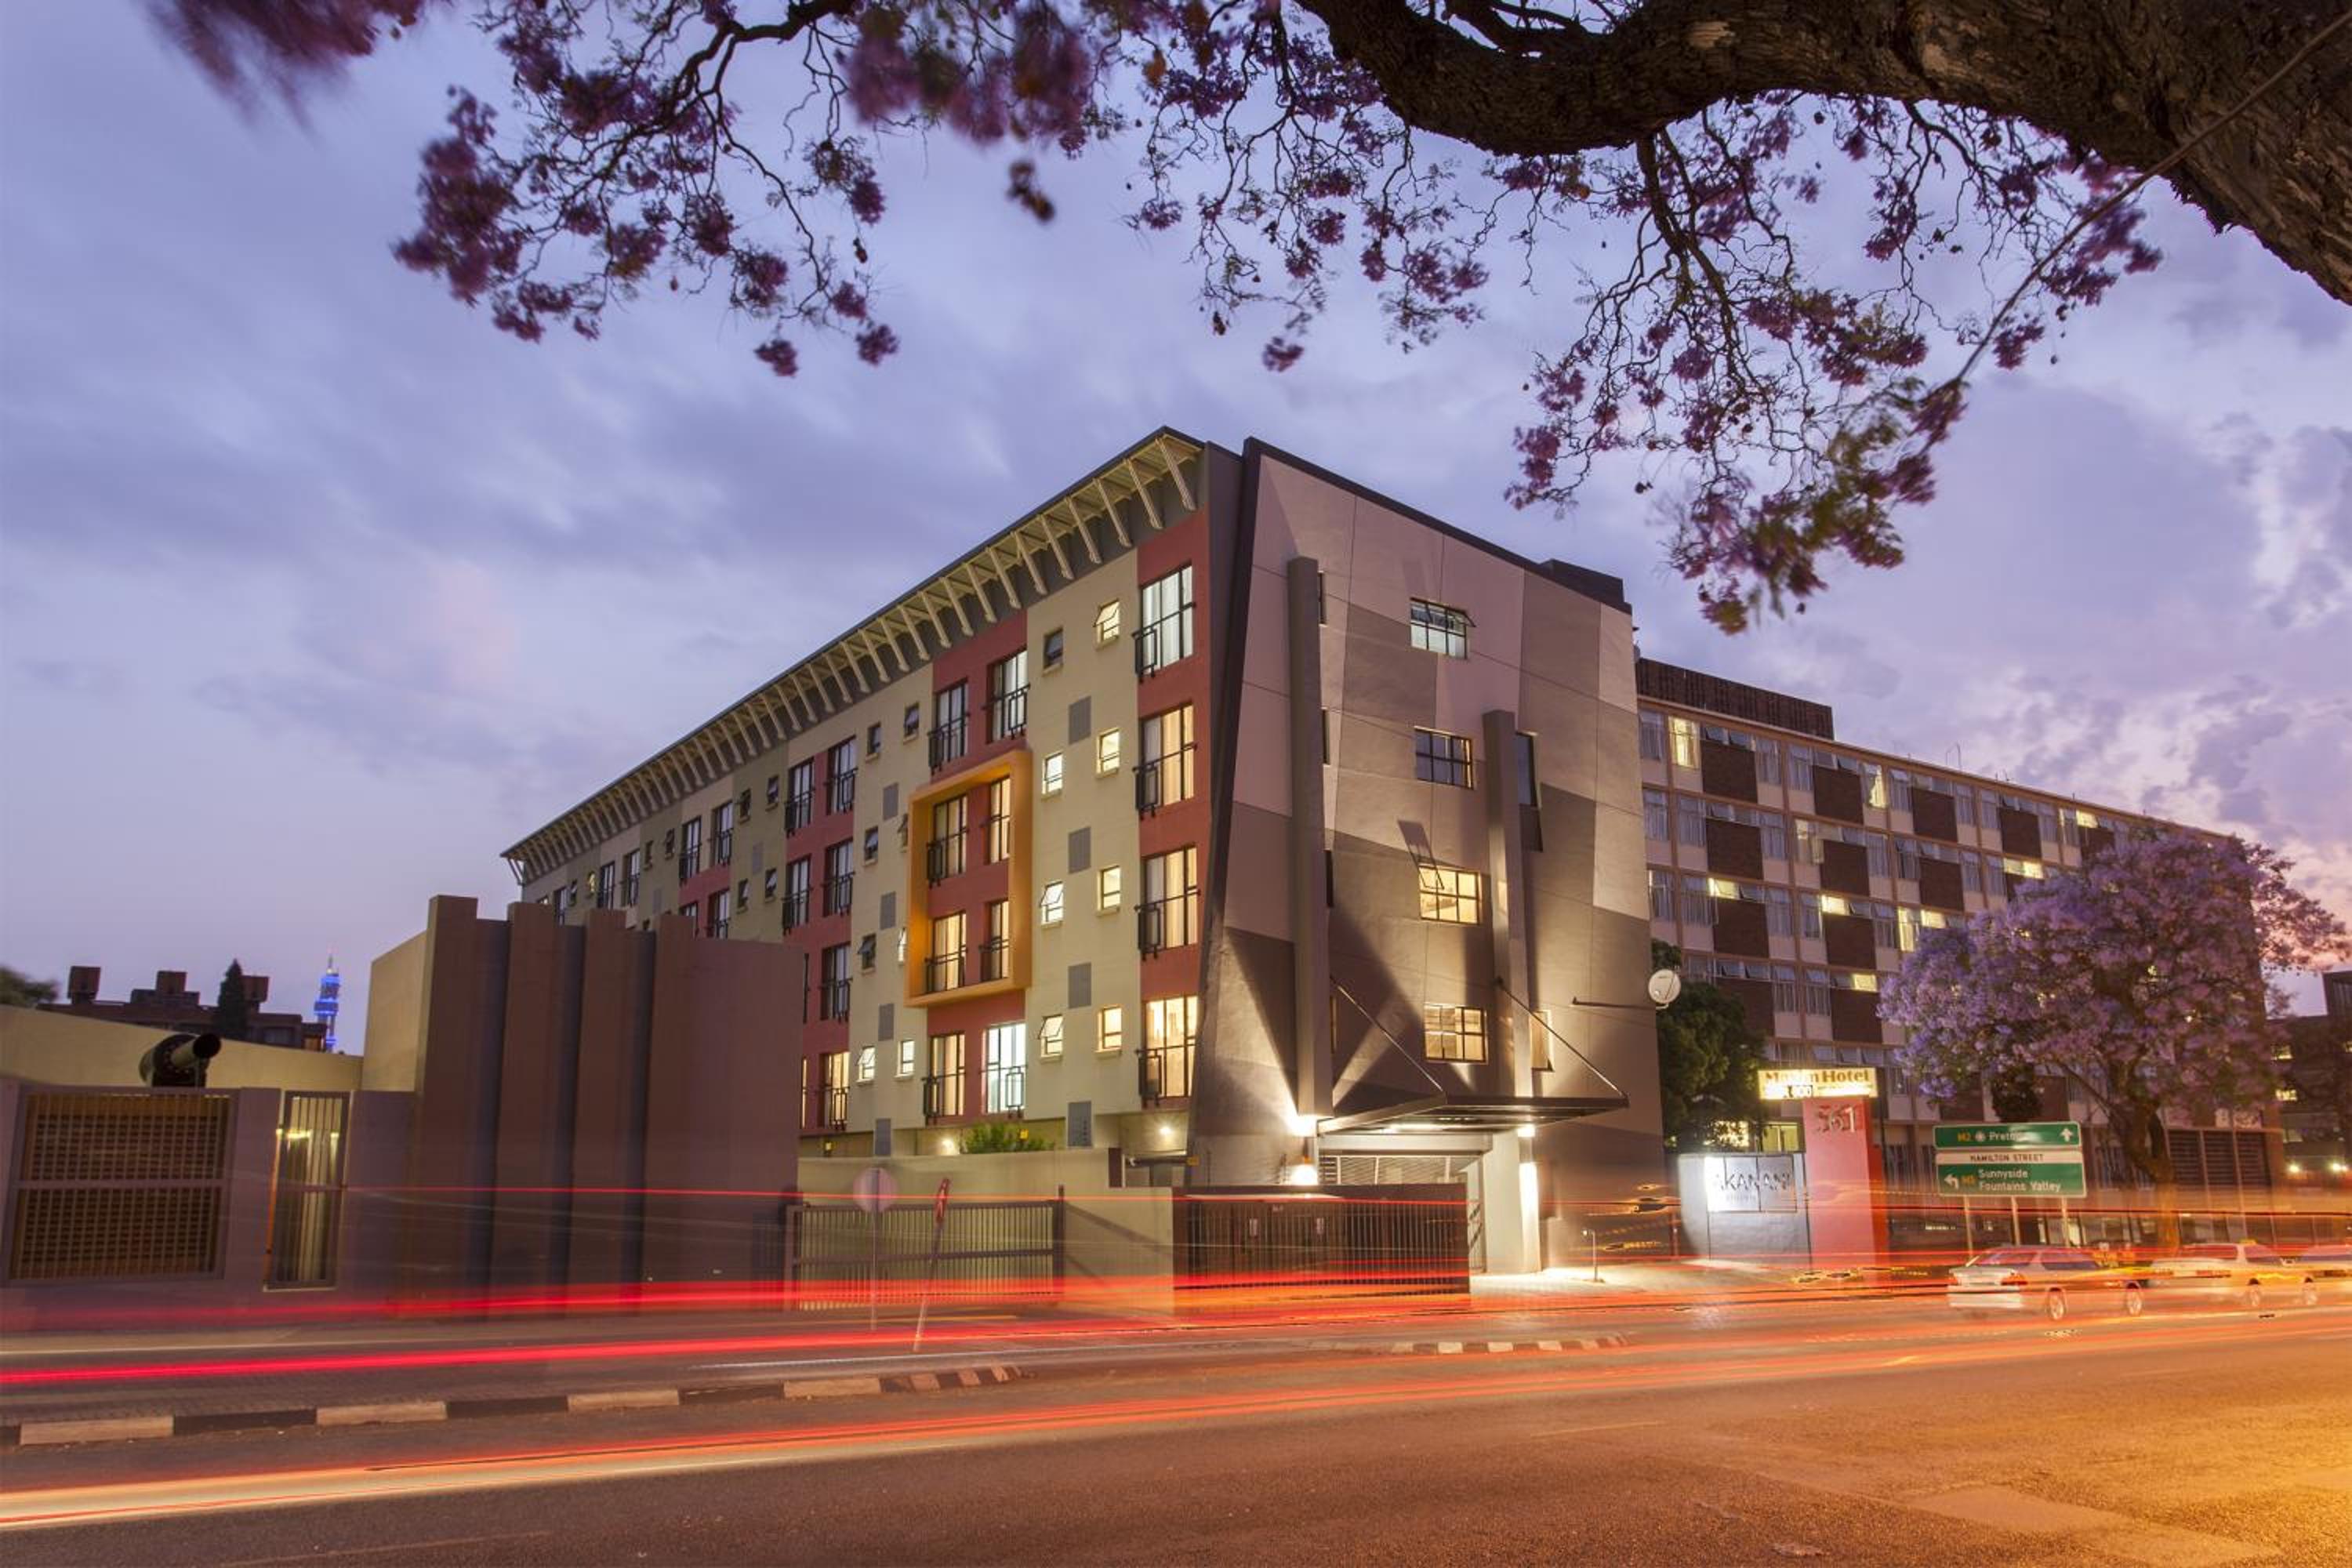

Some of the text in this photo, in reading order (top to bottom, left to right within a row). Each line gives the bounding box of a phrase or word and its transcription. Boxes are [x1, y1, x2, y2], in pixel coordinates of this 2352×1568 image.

[1822, 1070, 1869, 1083] Hotel
[1979, 1168, 2028, 1180] Sunnyside
[1980, 1180, 2061, 1192] Fountains Valley
